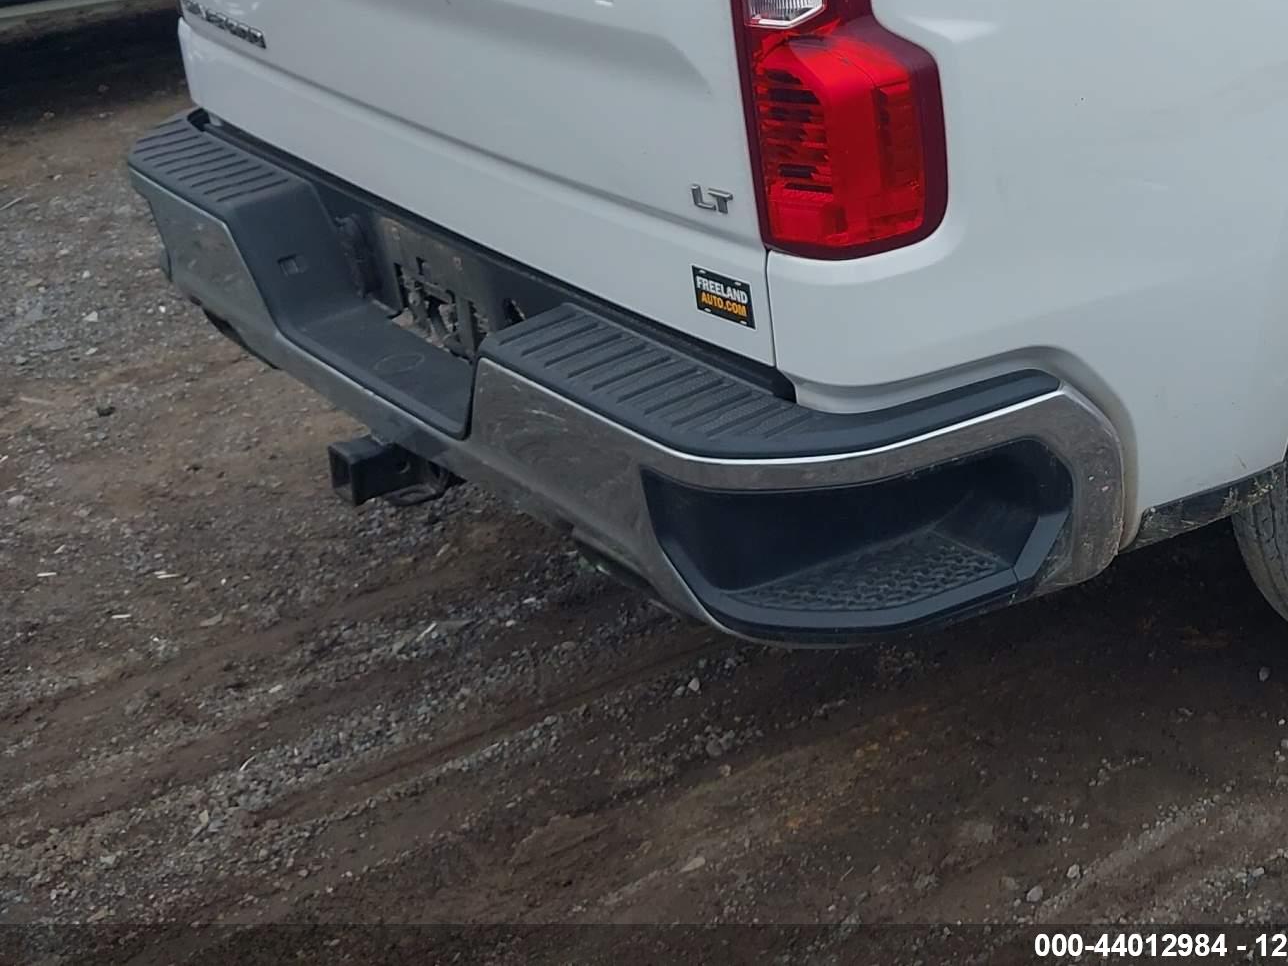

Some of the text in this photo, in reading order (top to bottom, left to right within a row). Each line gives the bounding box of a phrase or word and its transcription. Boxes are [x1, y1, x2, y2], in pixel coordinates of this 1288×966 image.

[691, 184, 733, 214] LT
[696, 276, 749, 305] FREELAND
[701, 292, 748, 318] AUTO.COM
